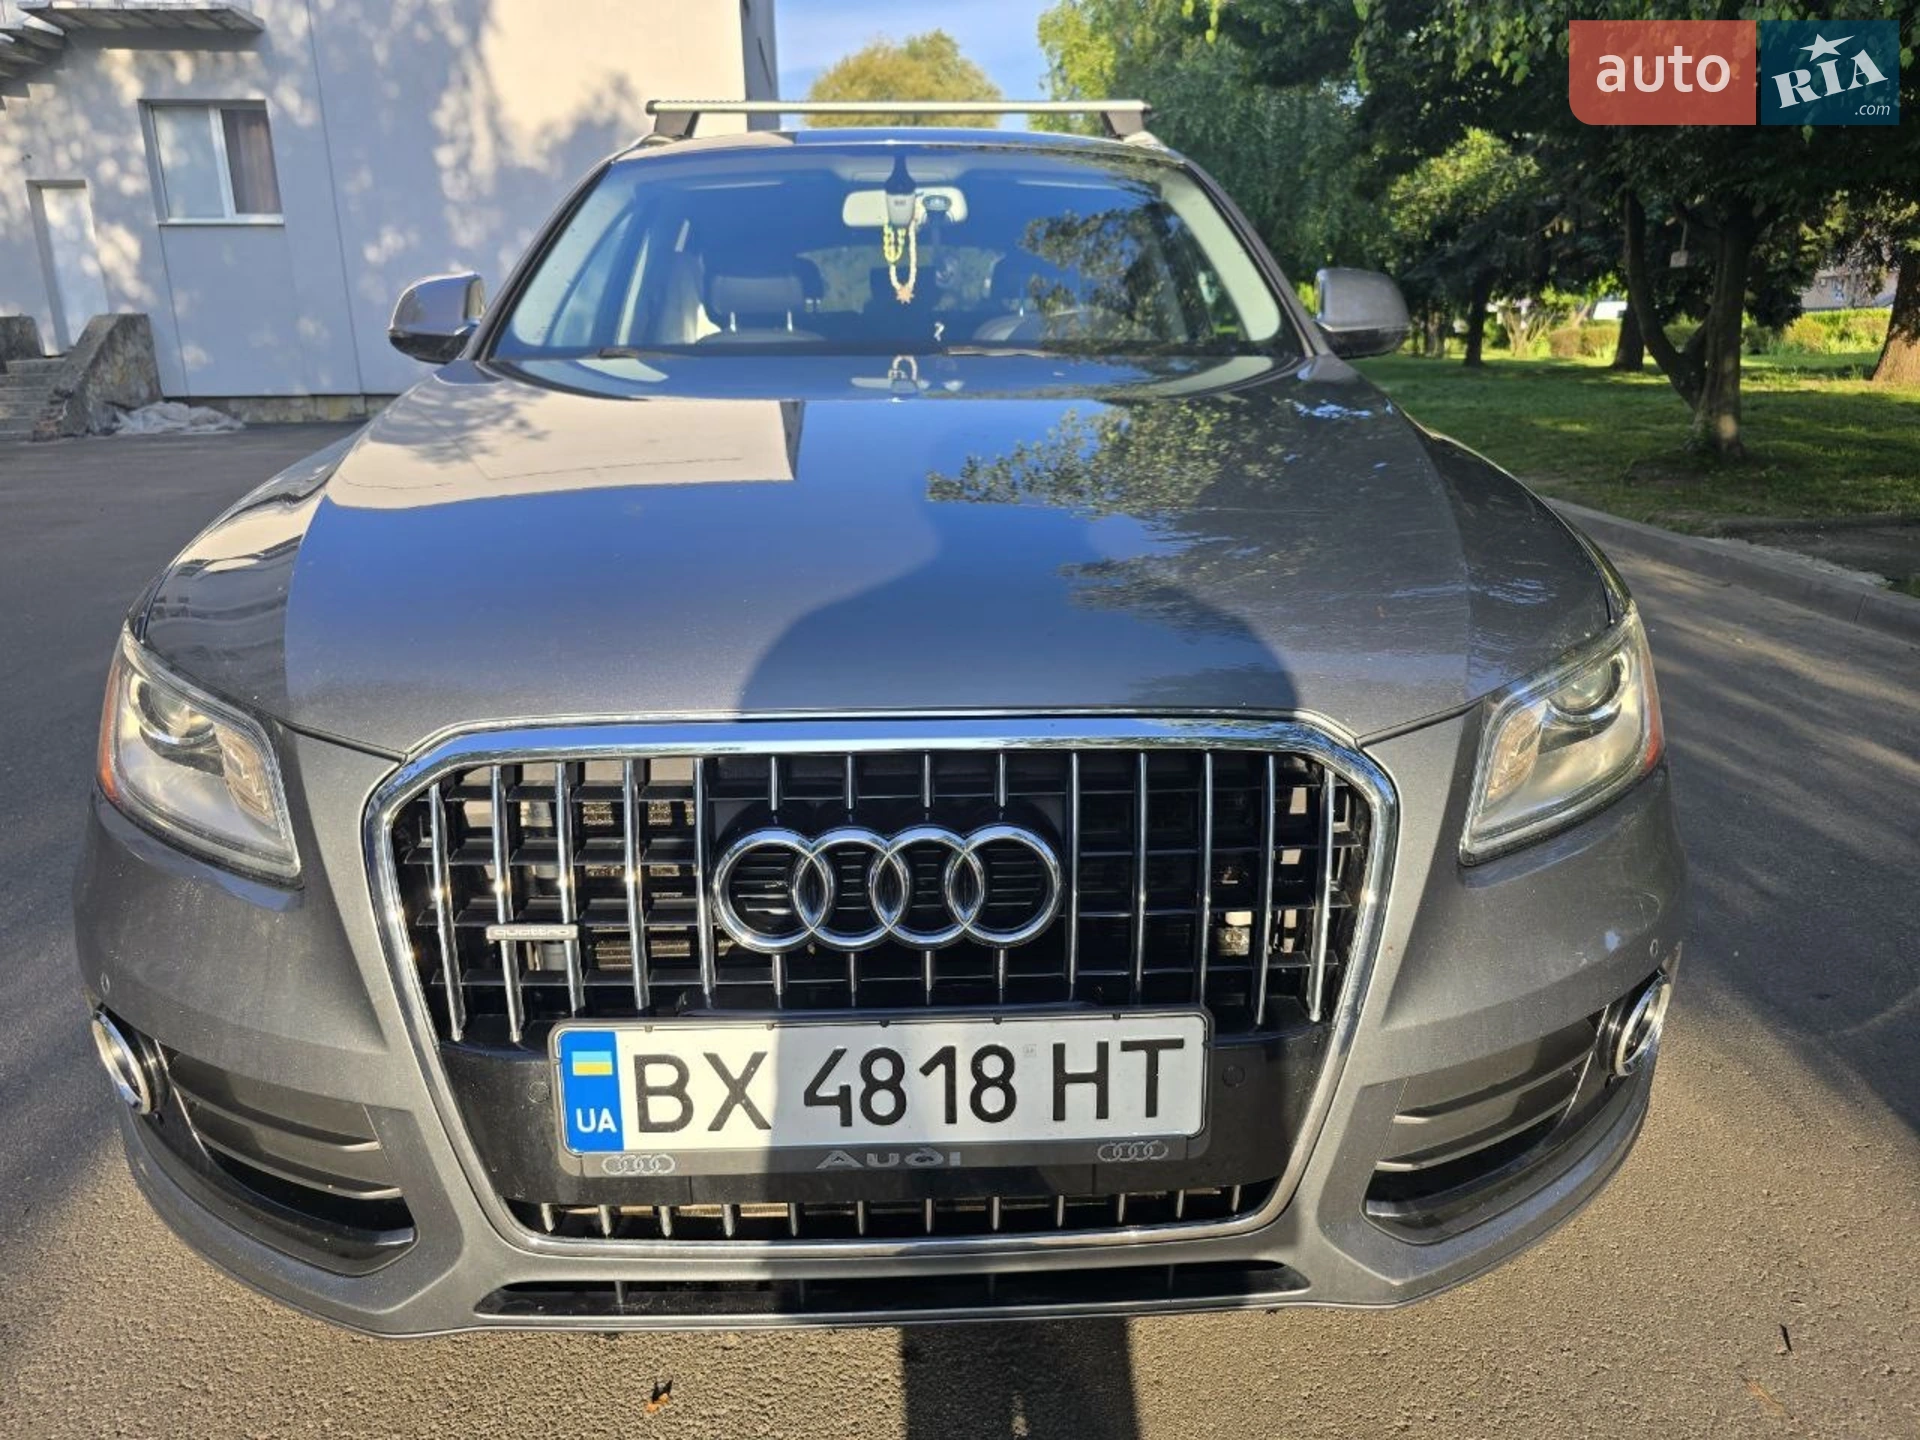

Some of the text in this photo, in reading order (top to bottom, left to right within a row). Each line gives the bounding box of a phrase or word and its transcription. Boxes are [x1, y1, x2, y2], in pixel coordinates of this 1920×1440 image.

[803, 1044, 1017, 1128] 4818
[1052, 1038, 1185, 1121] HT
[576, 1107, 617, 1133] UA
